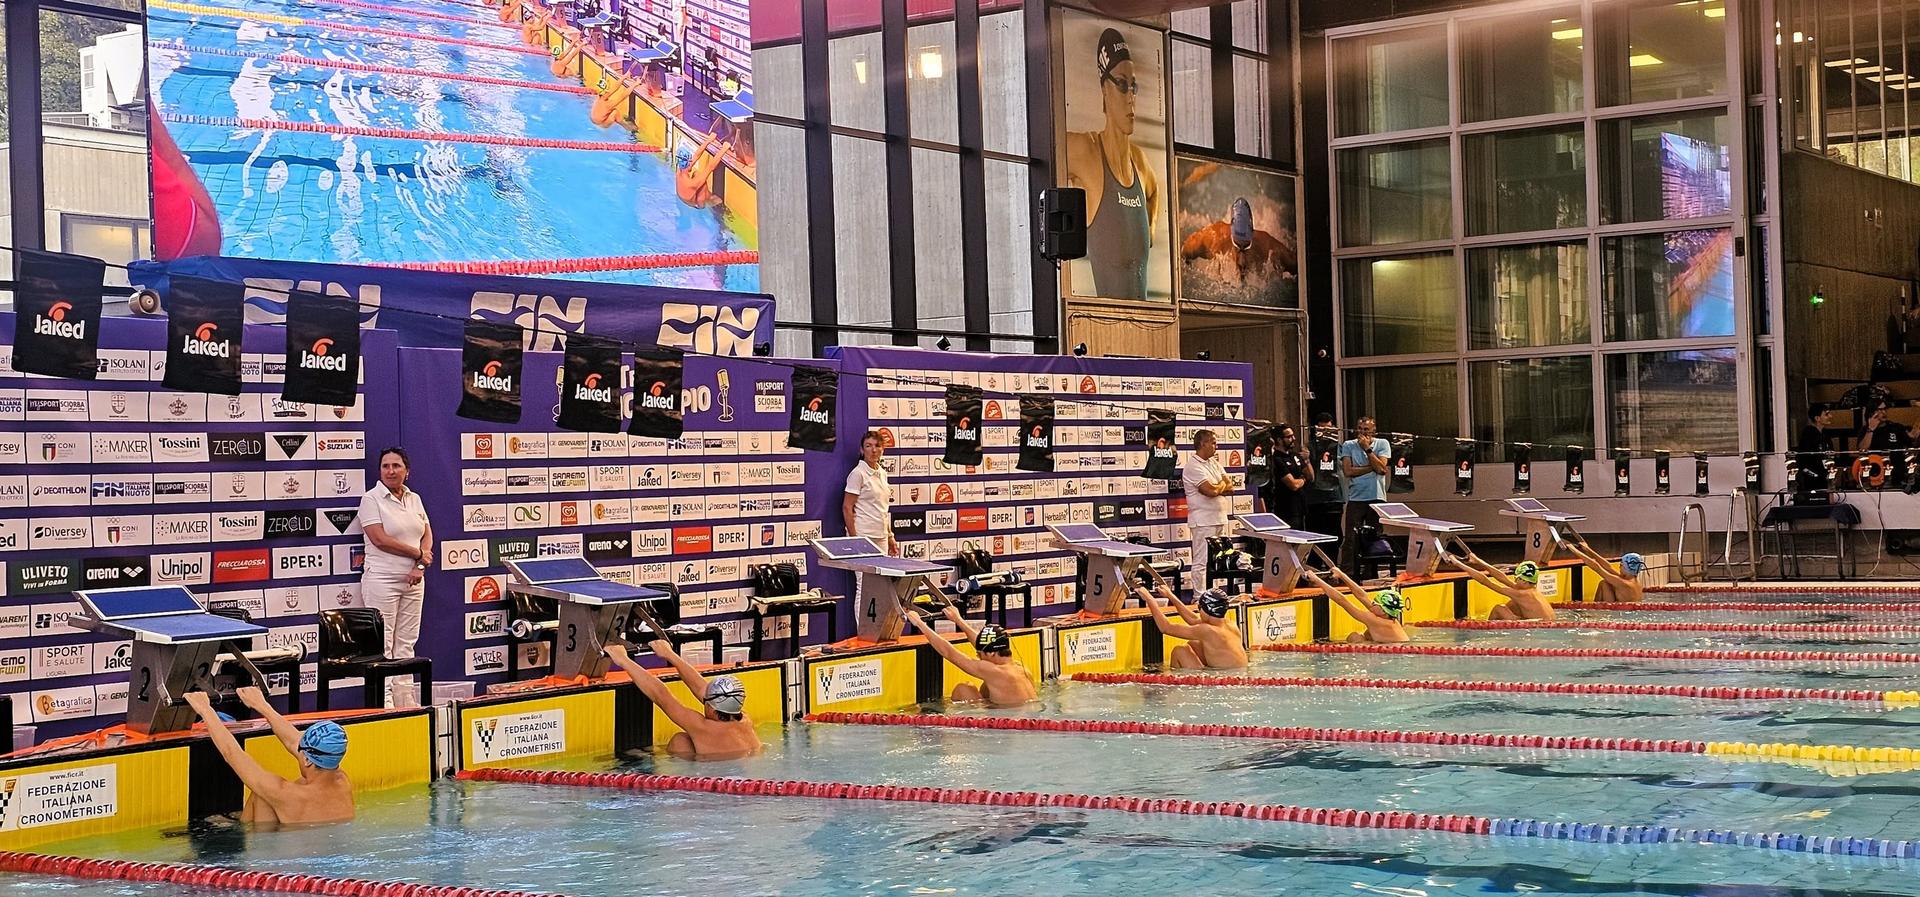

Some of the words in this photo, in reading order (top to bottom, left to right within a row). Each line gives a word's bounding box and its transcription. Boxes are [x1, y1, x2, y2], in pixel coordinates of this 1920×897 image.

[1117, 191, 1142, 208] Jaked
[34, 314, 85, 340] Jaked
[656, 303, 760, 356] FIN
[182, 335, 230, 358] Jaked
[110, 358, 146, 369] ISOLANI
[300, 350, 347, 371] Jaked
[473, 371, 512, 392] Jaked
[575, 384, 611, 403] Jaked
[641, 391, 674, 410] Jaked
[757, 397, 782, 406] SCIORBA
[799, 407, 829, 425] Jaked
[954, 426, 976, 441] Jaked
[1026, 434, 1048, 448] Jaked
[109, 440, 148, 453] MAKER
[602, 439, 627, 448] ISOLANI
[1153, 445, 1174, 459] Jaked
[599, 466, 624, 475] SPORT
[676, 470, 702, 480] Diversey
[184, 482, 208, 490] SCIORBA
[637, 475, 662, 487] Jaked
[44, 486, 87, 495] DECATHLON
[92, 481, 125, 498] FIN
[169, 520, 208, 534] MAKER
[931, 513, 953, 530] Unipol
[44, 527, 87, 539] Diversey
[1533, 532, 1541, 549] 8
[498, 542, 530, 554] ULIVETO
[588, 540, 612, 551] arena
[639, 533, 667, 552] Unipol
[1415, 541, 1424, 559] 7
[447, 544, 486, 565] enel
[161, 556, 203, 581] Unipol
[217, 558, 266, 569] FRECCIAROSSA
[643, 563, 666, 573] SPORT
[1271, 556, 1280, 576] 6
[22, 565, 69, 580] ULIVETO
[86, 567, 120, 580] arena
[678, 571, 700, 582] Jaked
[1093, 574, 1103, 596] 5
[866, 597, 877, 623] 4
[566, 623, 577, 652] 3
[46, 645, 86, 659] SPORT
[55, 656, 85, 667] SALUTE
[104, 654, 133, 669] Jake
[838, 668, 877, 681] FEDERAZIONE
[138, 666, 150, 701] 2
[845, 679, 871, 689] ITALIANA
[835, 686, 881, 700] CRONOMETRISTI
[504, 720, 558, 734] FEDERAZIONE
[514, 732, 549, 744] ITALIANA
[499, 741, 563, 758] CRONOMETRISTI
[27, 778, 107, 797] FEDERAZIONE
[41, 793, 93, 809] ITALIANA
[20, 803, 113, 825] CRONOMETRISTI
